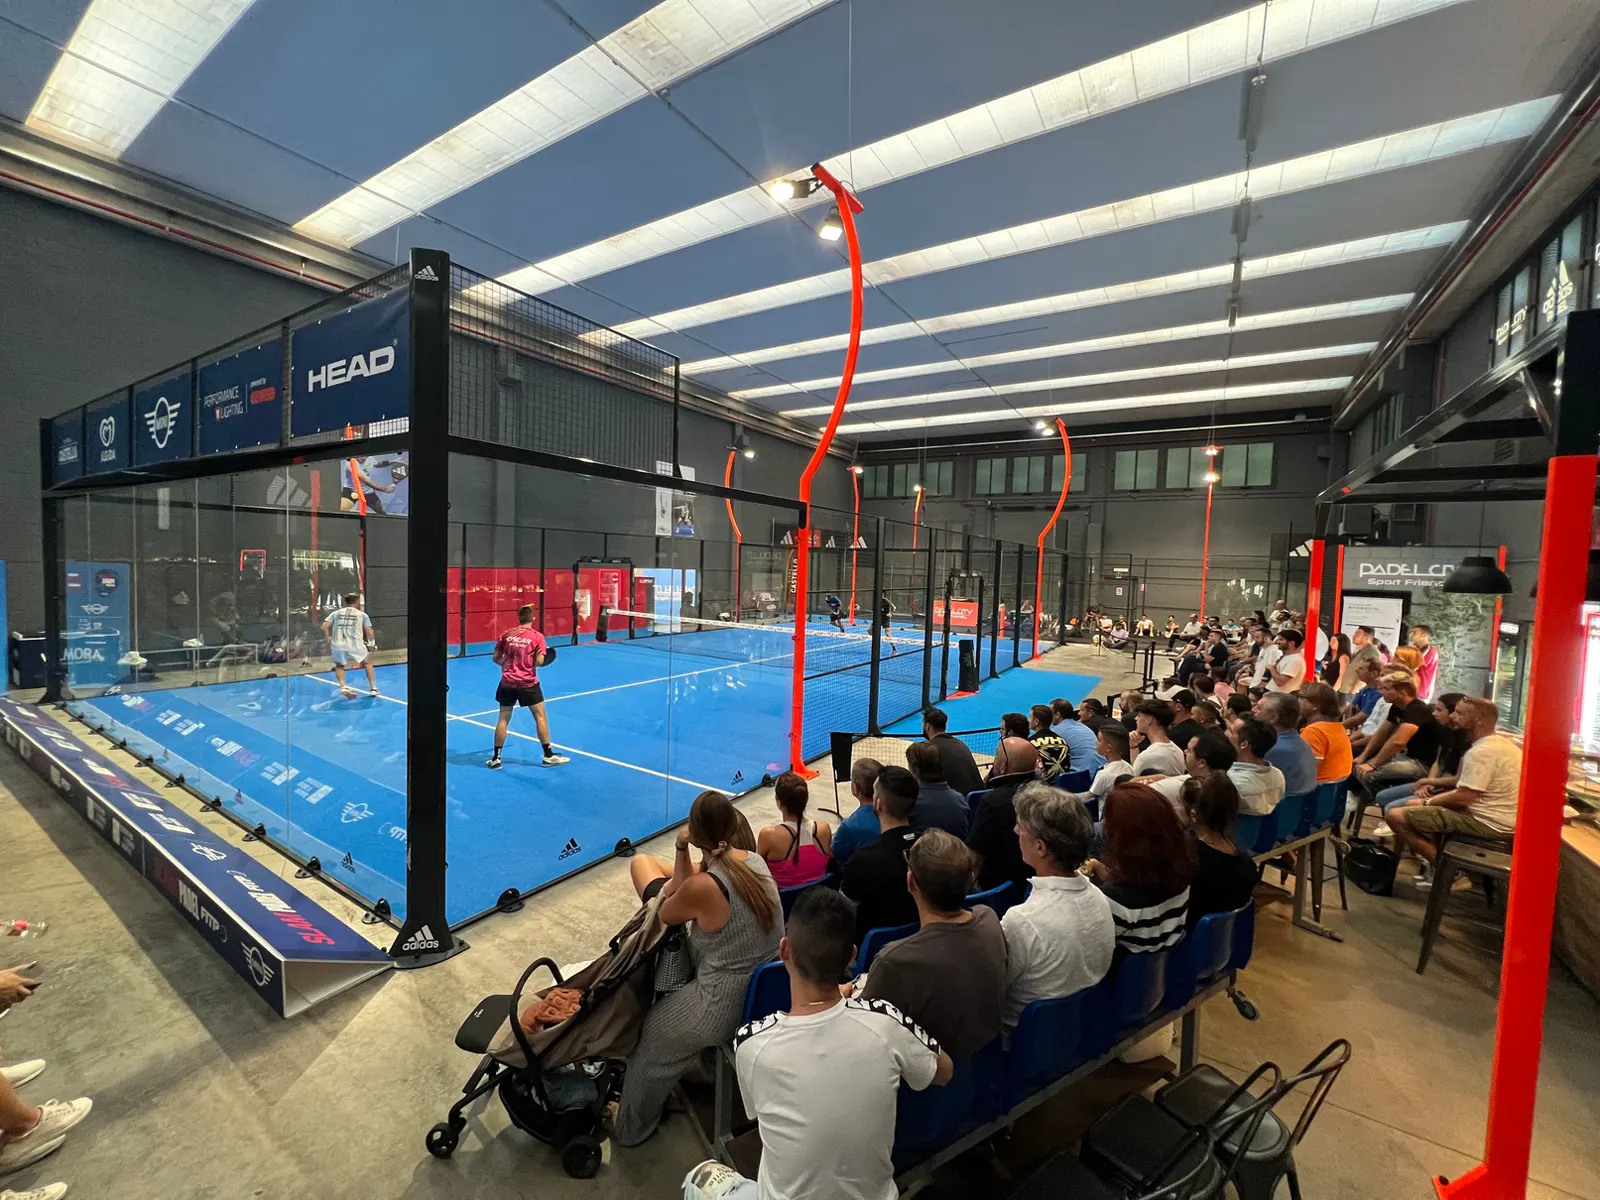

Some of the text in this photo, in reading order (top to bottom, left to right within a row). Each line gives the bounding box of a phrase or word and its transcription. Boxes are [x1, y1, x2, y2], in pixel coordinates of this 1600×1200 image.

[414, 273, 440, 282] adidas
[308, 345, 395, 393] HEAD
[204, 385, 240, 408] PERFORMANCE
[220, 401, 244, 419] LIGHTING
[1359, 562, 1428, 578] PADEL
[1367, 578, 1401, 587] Sport
[558, 846, 582, 861] adidas
[402, 940, 440, 952] adidas
